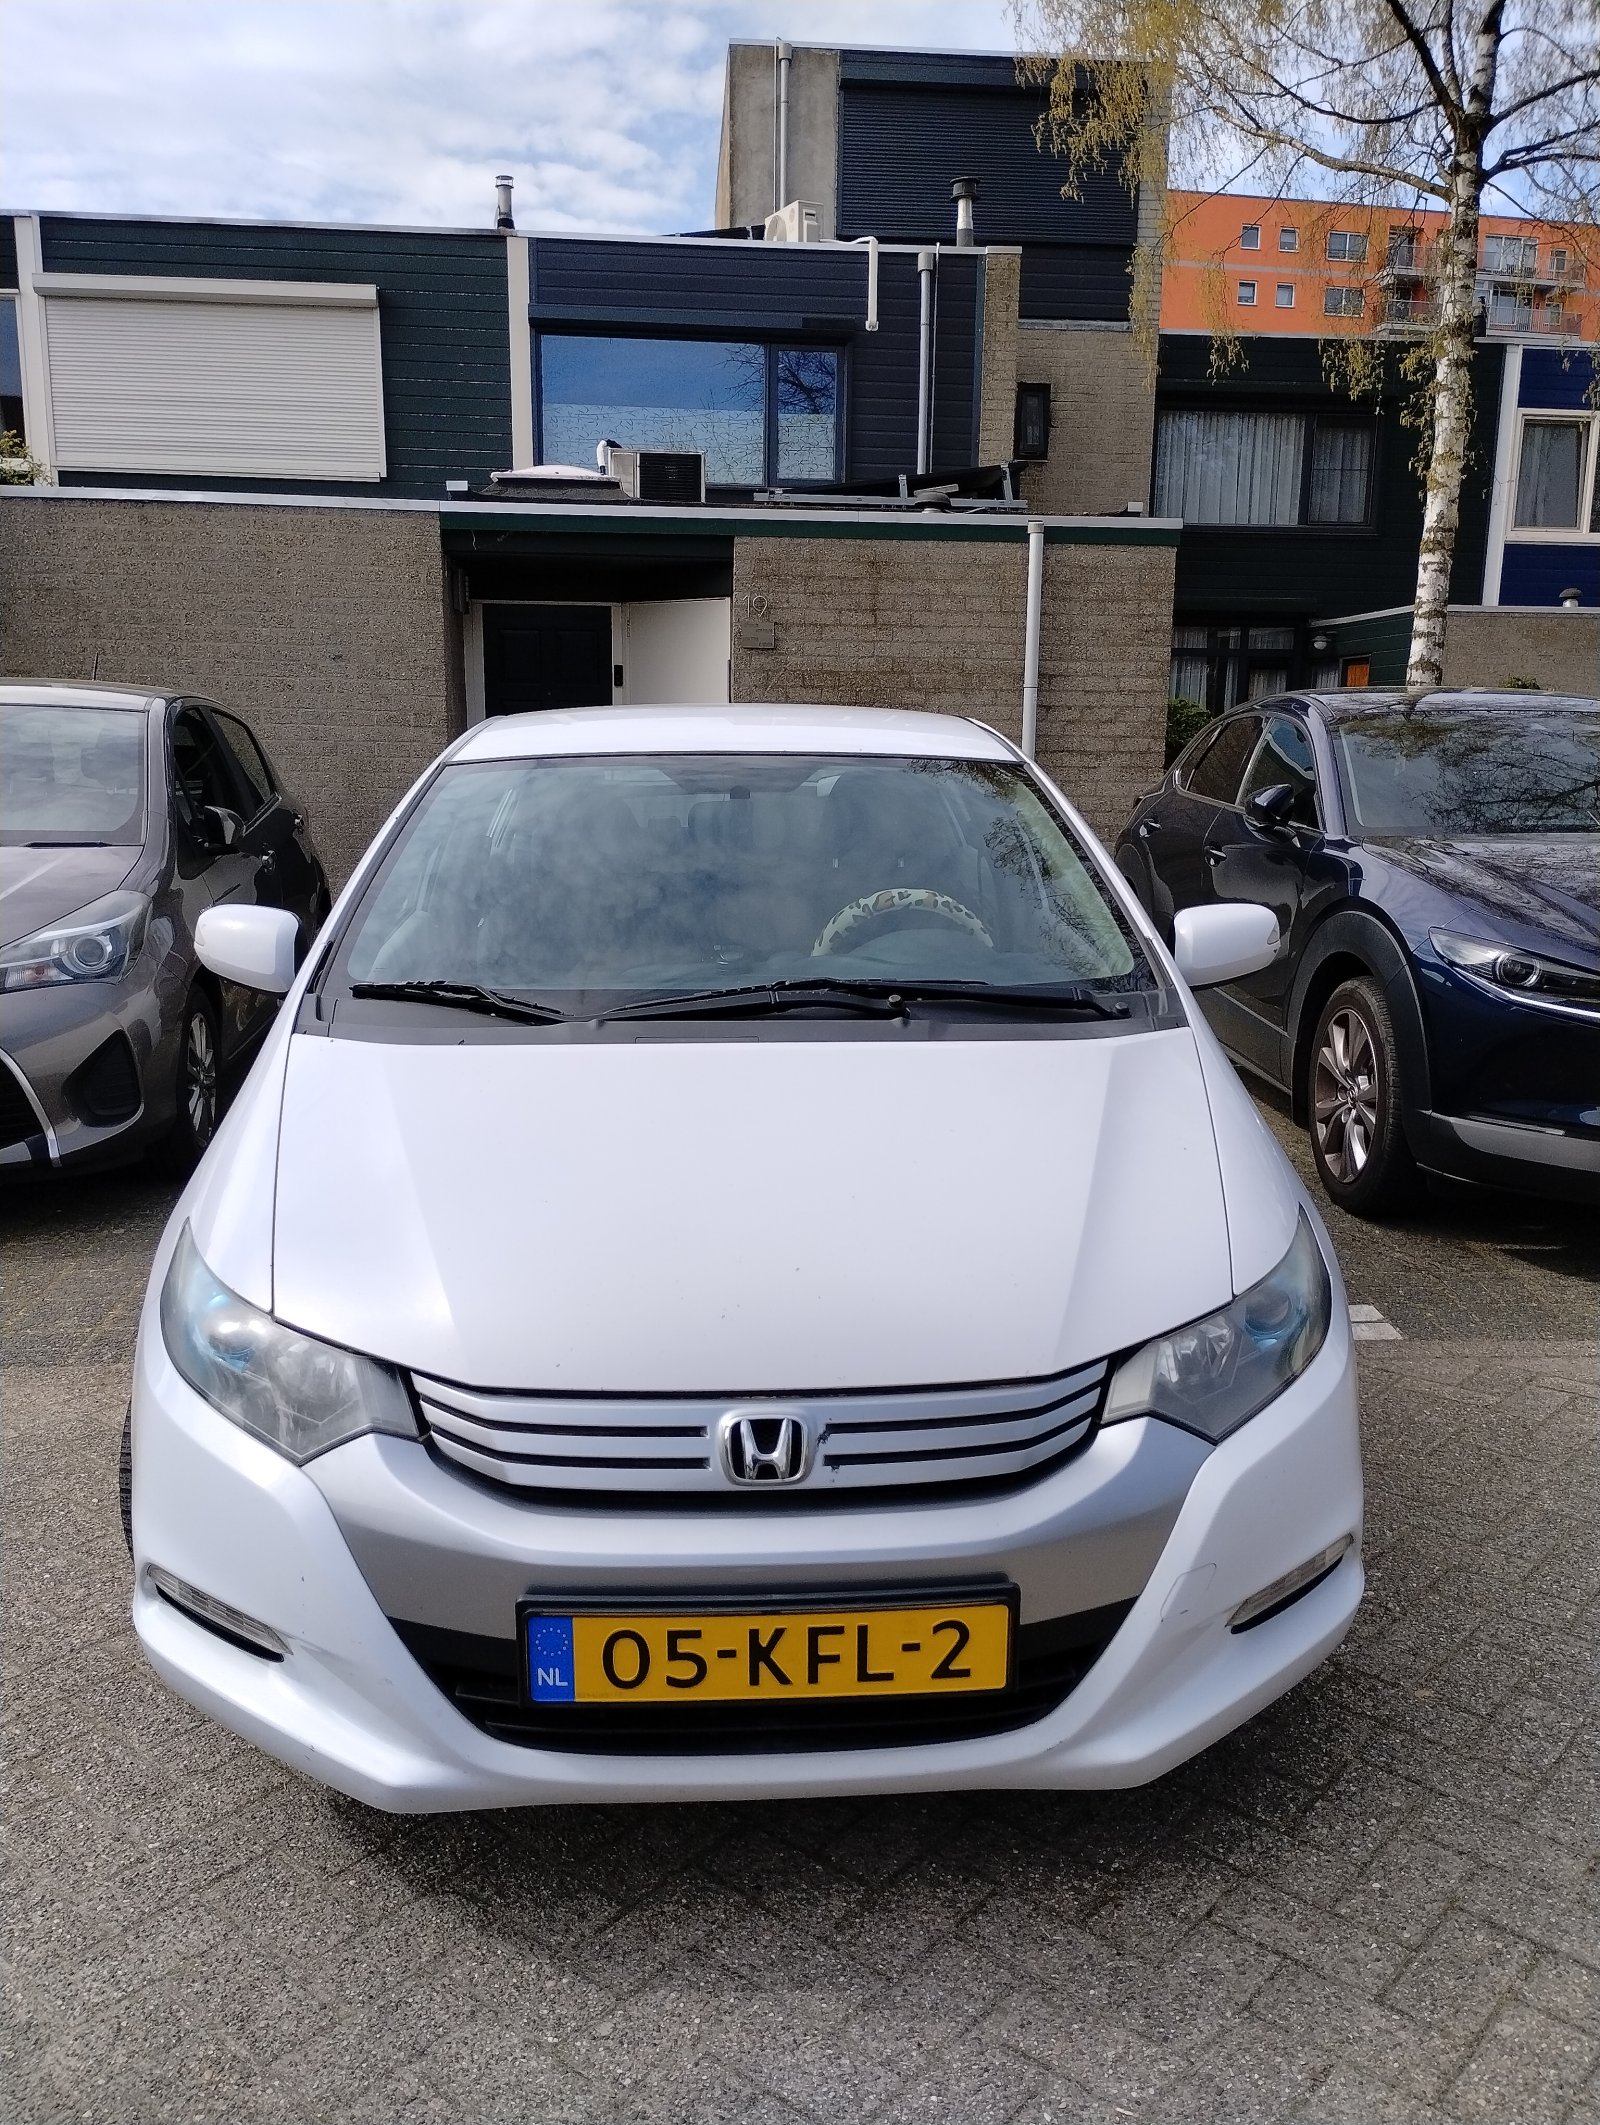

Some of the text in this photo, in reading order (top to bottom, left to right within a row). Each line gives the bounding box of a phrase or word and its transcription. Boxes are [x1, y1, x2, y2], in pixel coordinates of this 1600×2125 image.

[742, 594, 768, 618] 19
[601, 1620, 972, 1690] 05-KFL-2
[537, 1667, 569, 1687] NL
